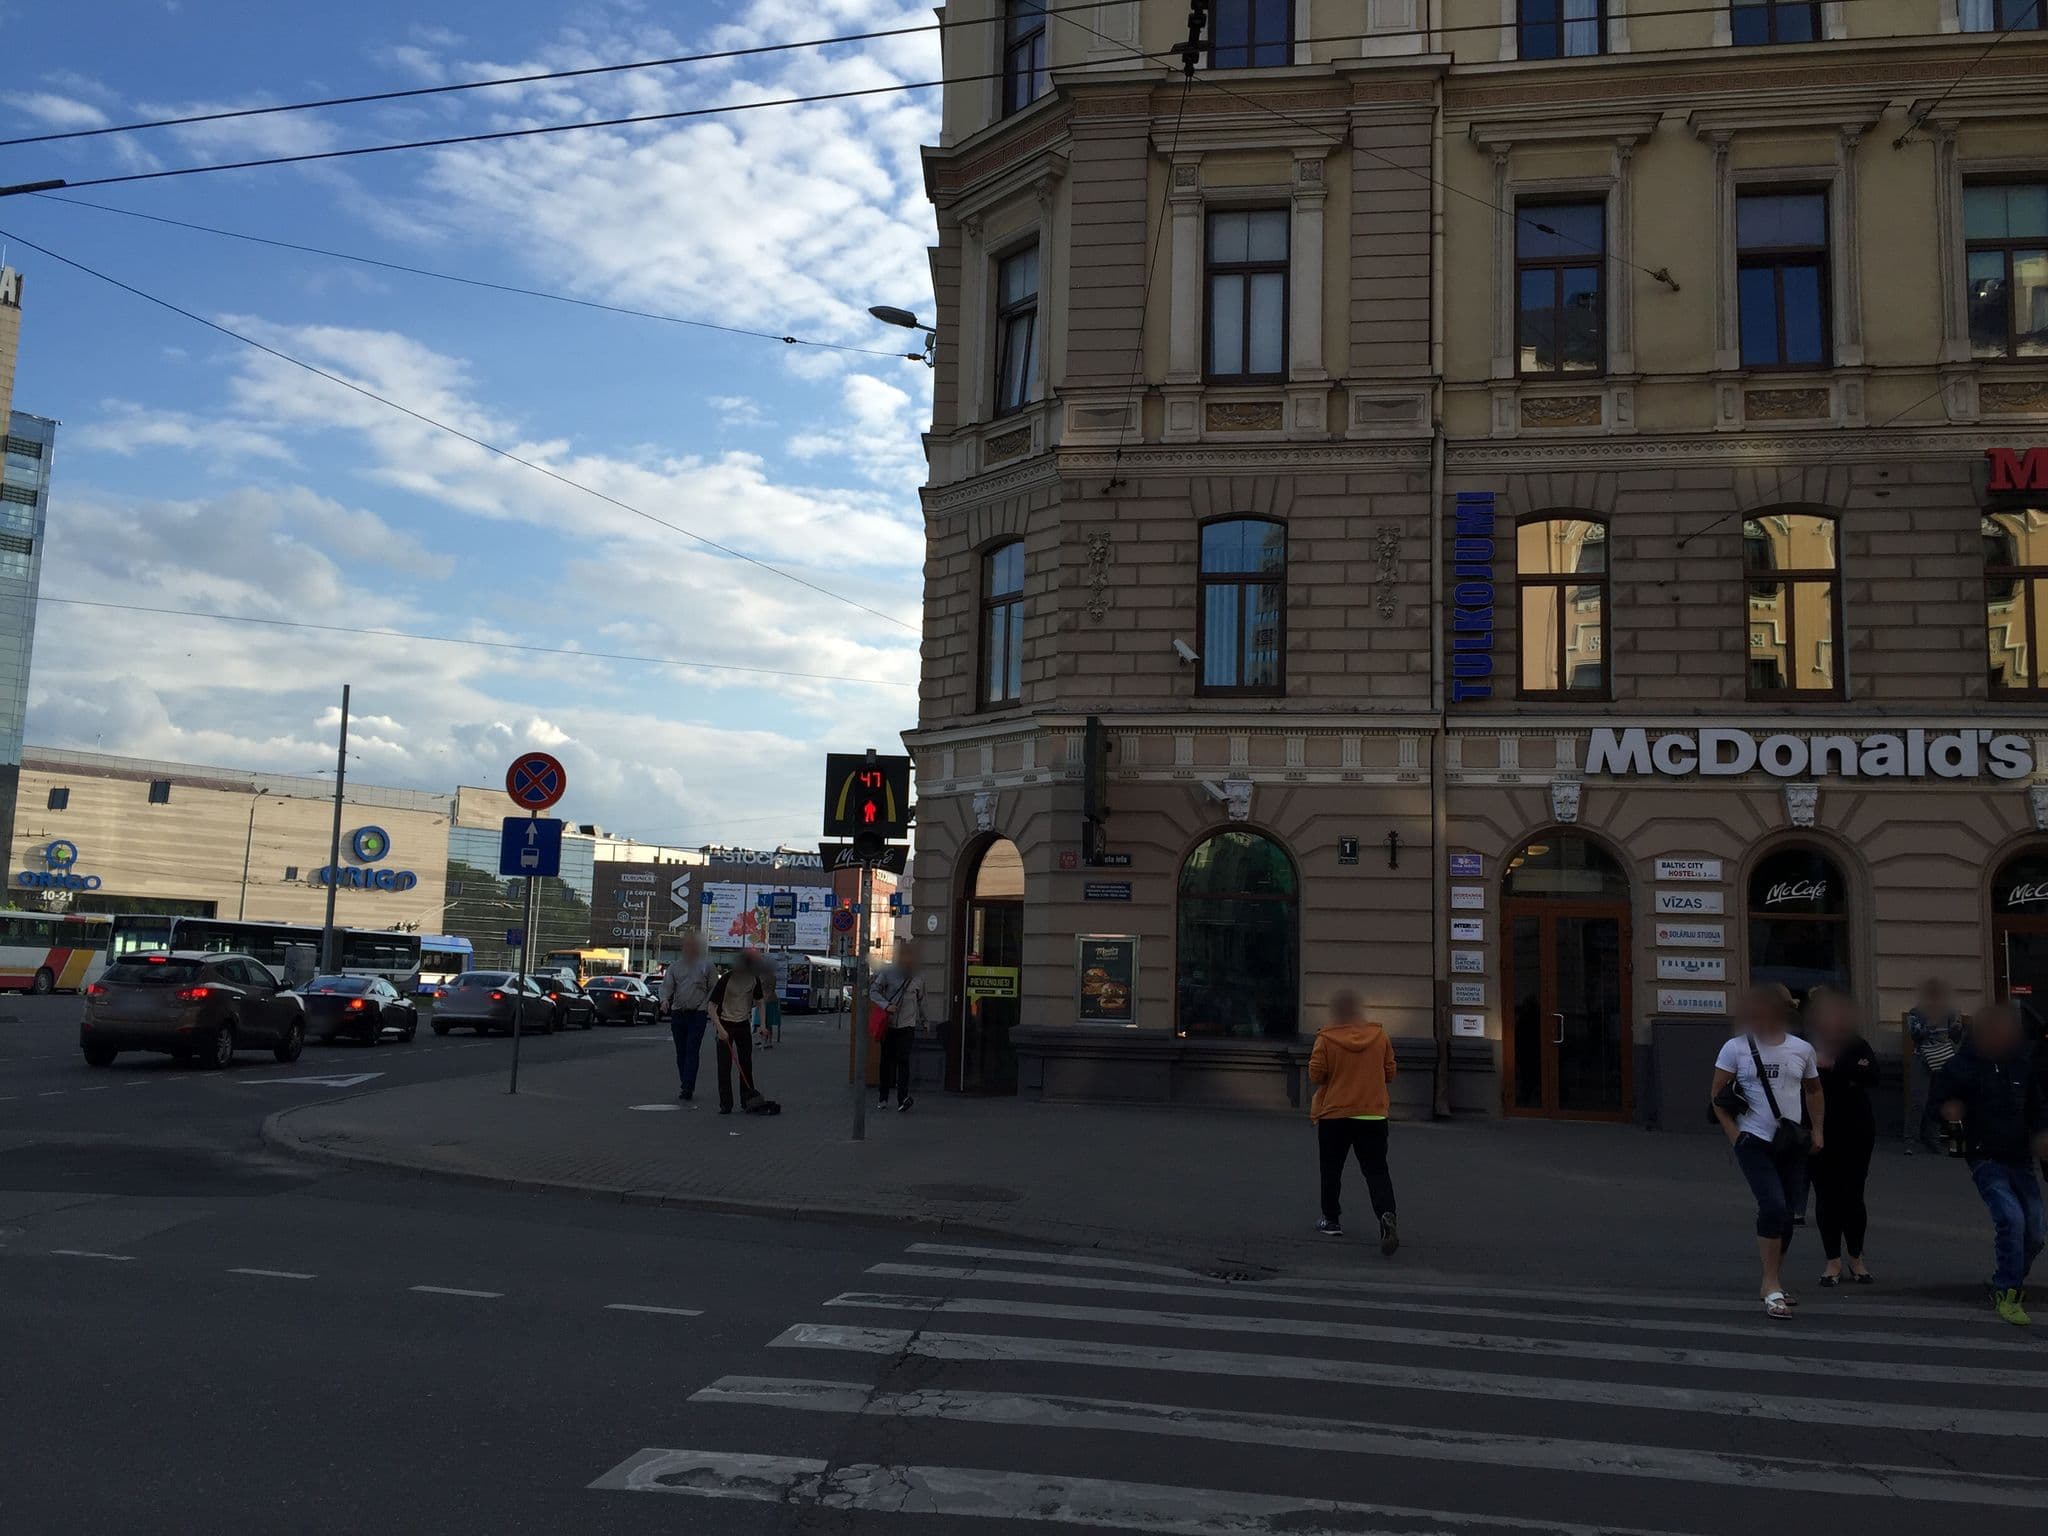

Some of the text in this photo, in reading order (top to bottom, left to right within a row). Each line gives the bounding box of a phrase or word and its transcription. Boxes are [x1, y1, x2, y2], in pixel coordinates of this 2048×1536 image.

[1452, 491, 1495, 703] TULKOJUMI
[1585, 728, 2034, 779] McDonald's
[860, 771, 881, 788] 47
[1344, 842, 1350, 854] 1
[723, 850, 825, 868] STOCKMAN
[18, 871, 102, 890] ORIGO
[320, 866, 417, 890] ORIGO
[41, 890, 74, 901] 10-21
[1765, 880, 1828, 904] McCafé
[1662, 896, 1703, 908] VĪZAS
